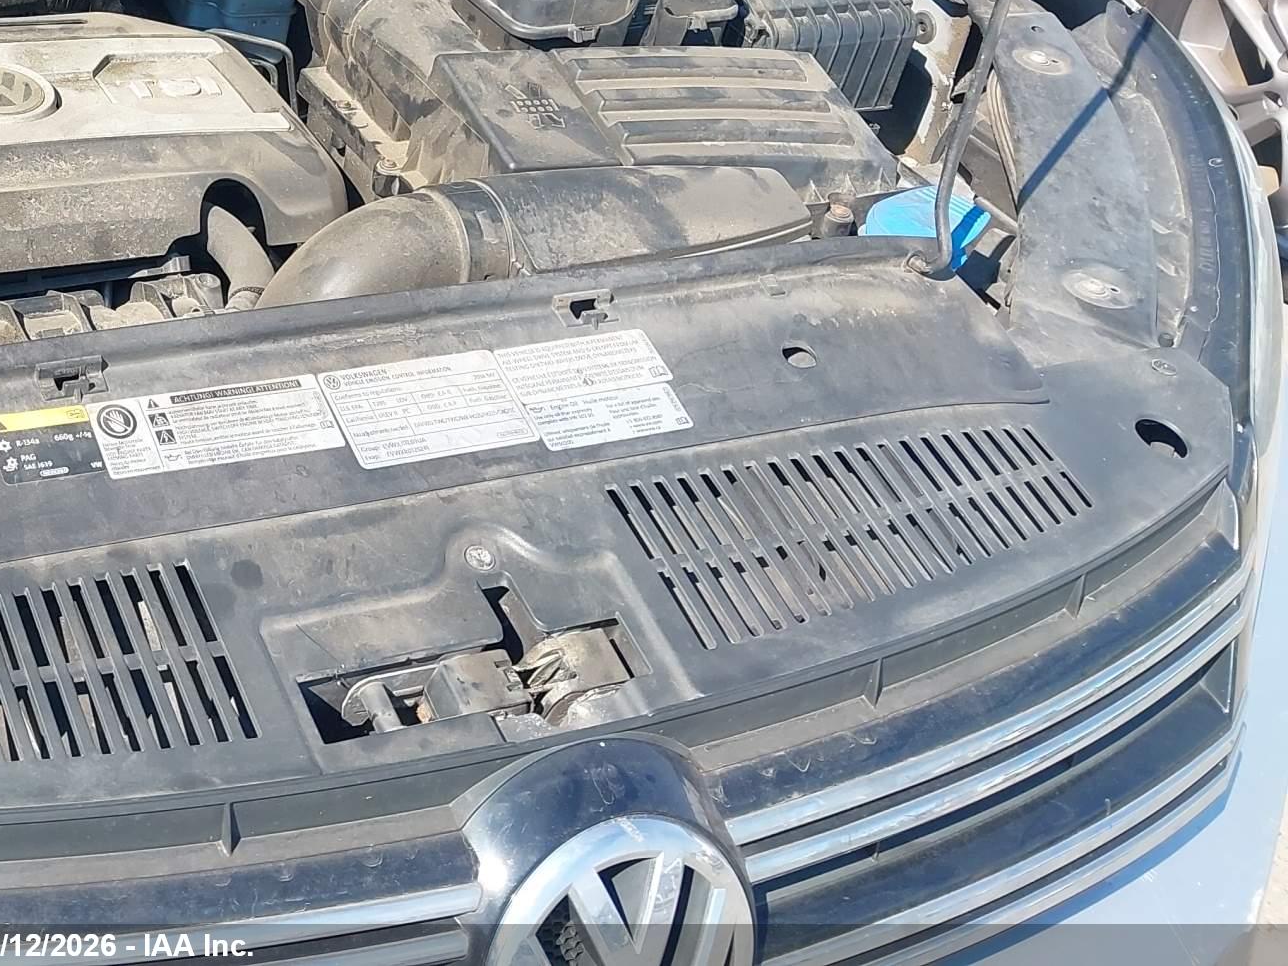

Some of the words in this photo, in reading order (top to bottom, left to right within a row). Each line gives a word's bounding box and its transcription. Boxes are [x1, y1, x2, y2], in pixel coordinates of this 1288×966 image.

[340, 368, 387, 381] VOLKSWAGEN
[174, 391, 214, 403] ACHTUNG!
[215, 386, 254, 398] WARNING!
[255, 380, 298, 393] ATTENTION!
[20, 453, 37, 462] PAG
